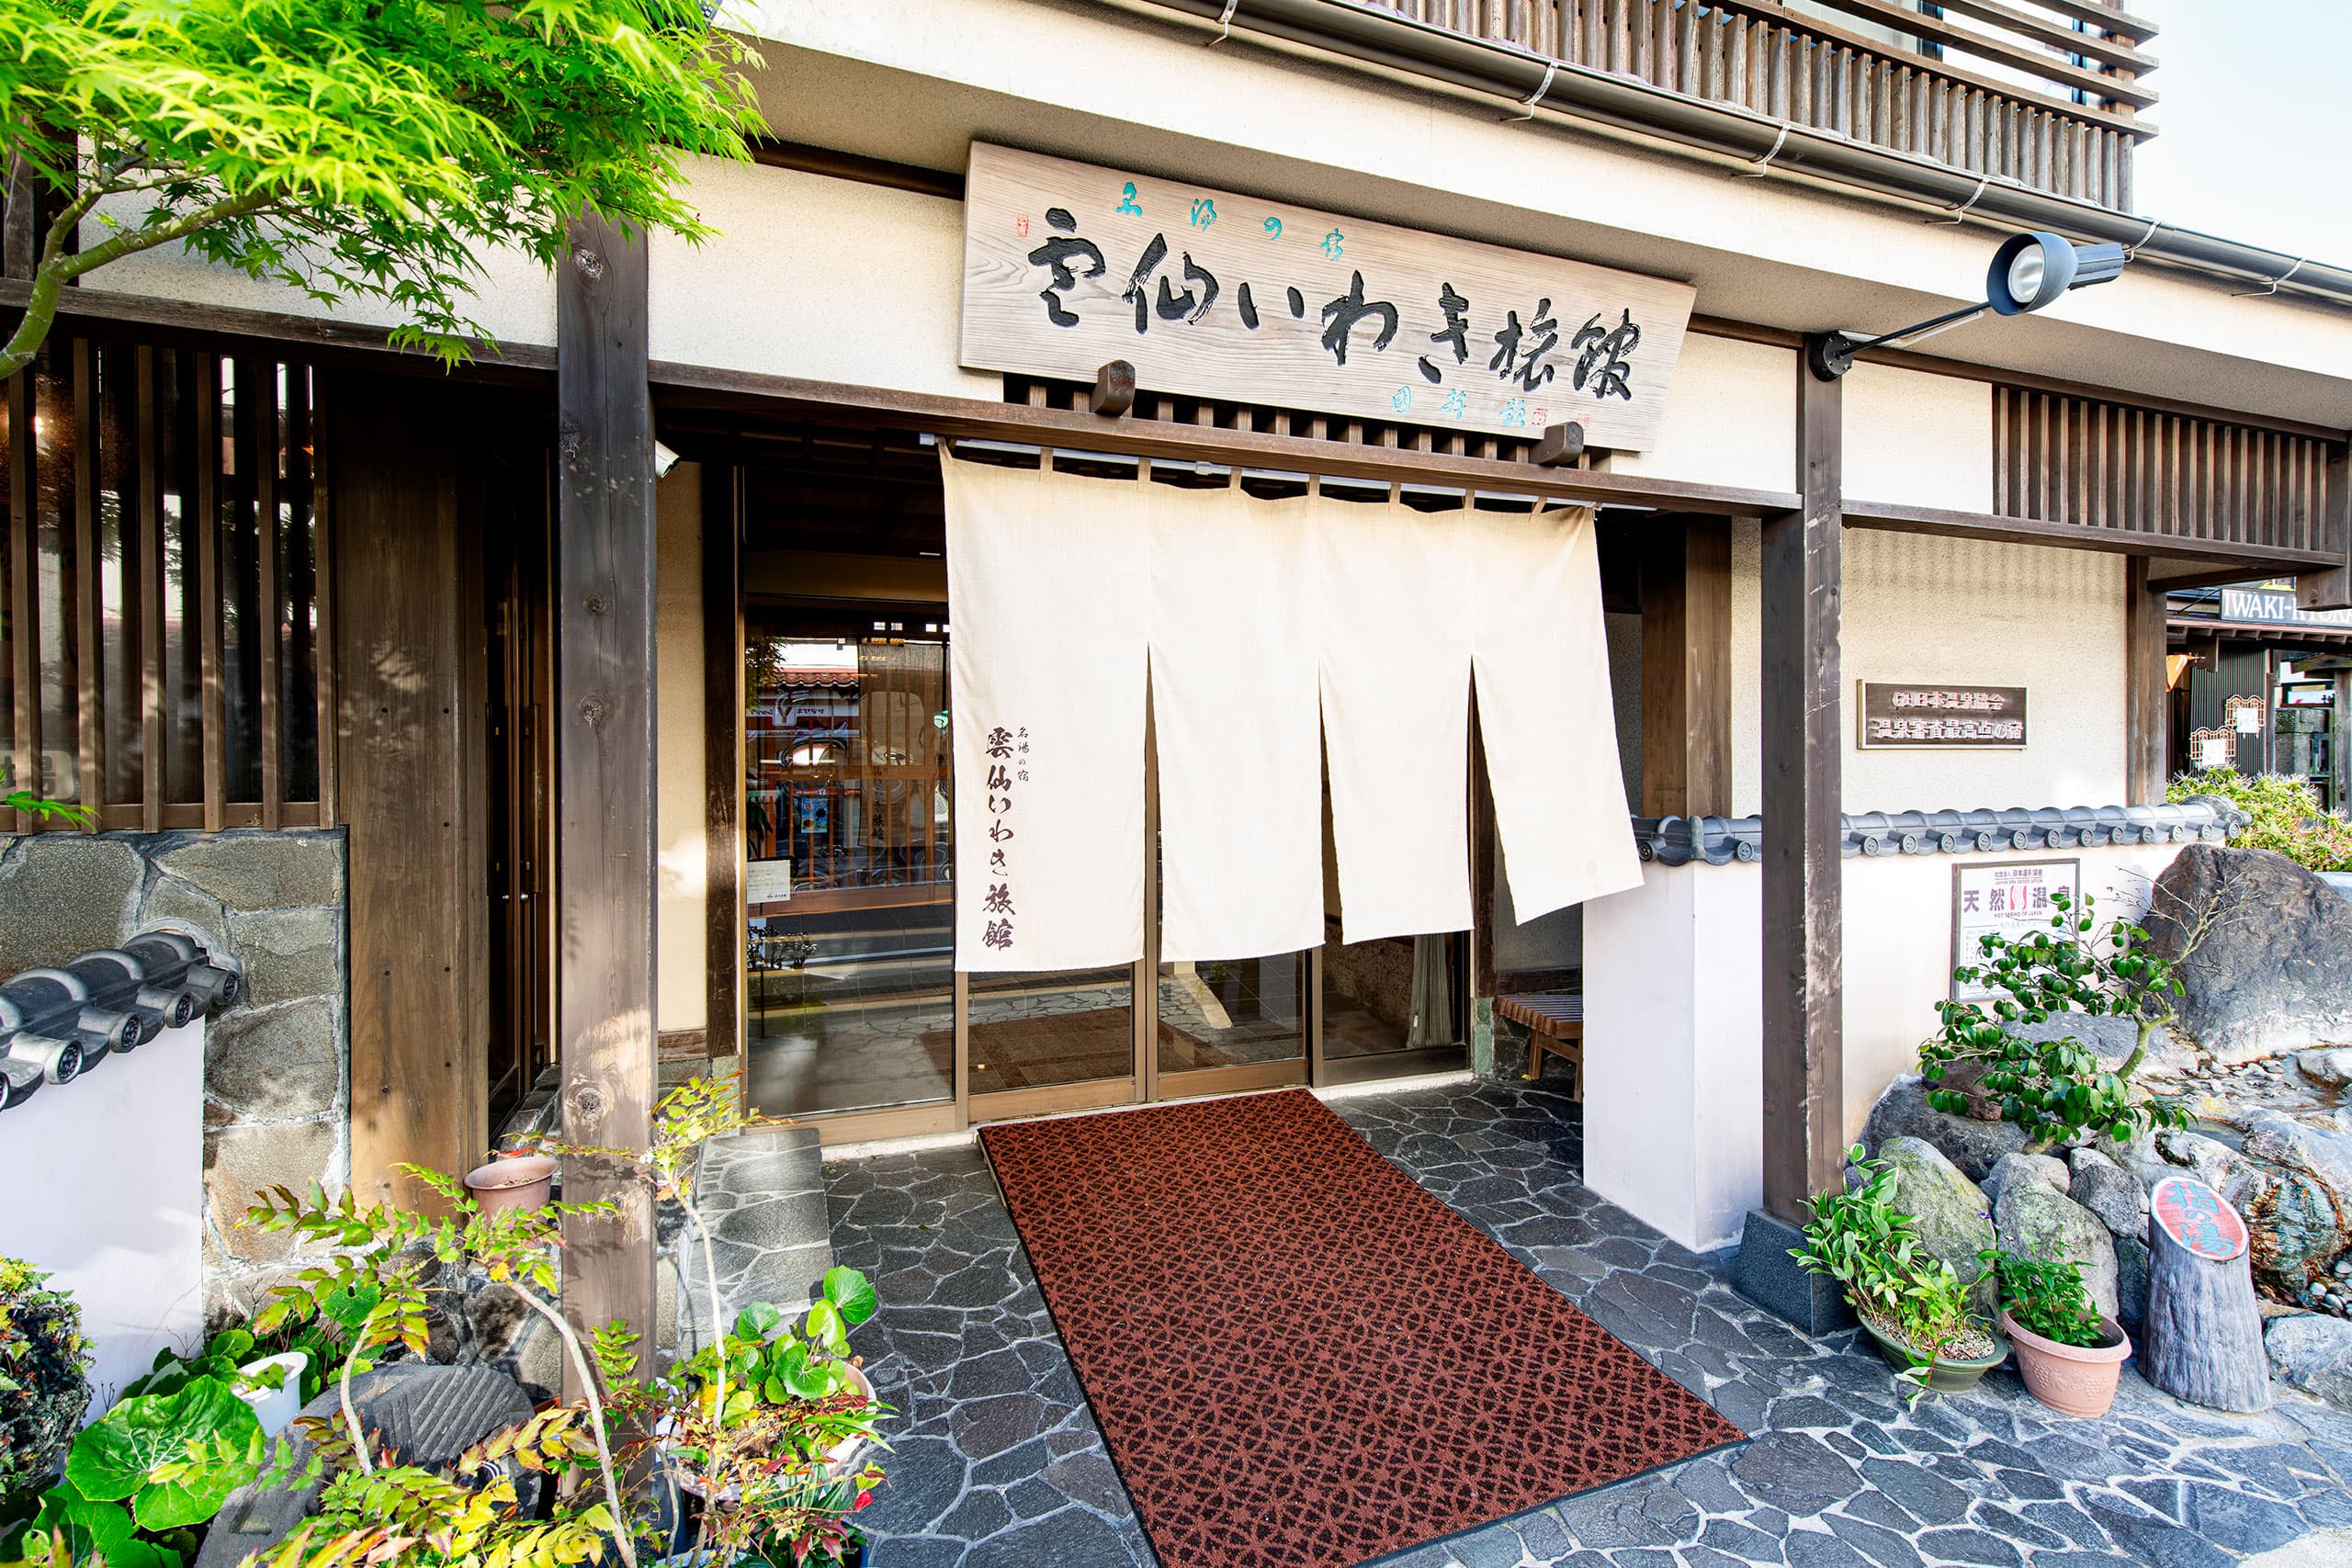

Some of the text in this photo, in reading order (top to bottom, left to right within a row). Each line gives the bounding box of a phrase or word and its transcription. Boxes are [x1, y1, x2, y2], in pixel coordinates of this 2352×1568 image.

[1017, 726, 1030, 782] 名湯の宿
[982, 727, 1015, 952] 雲仙いわき旅館
